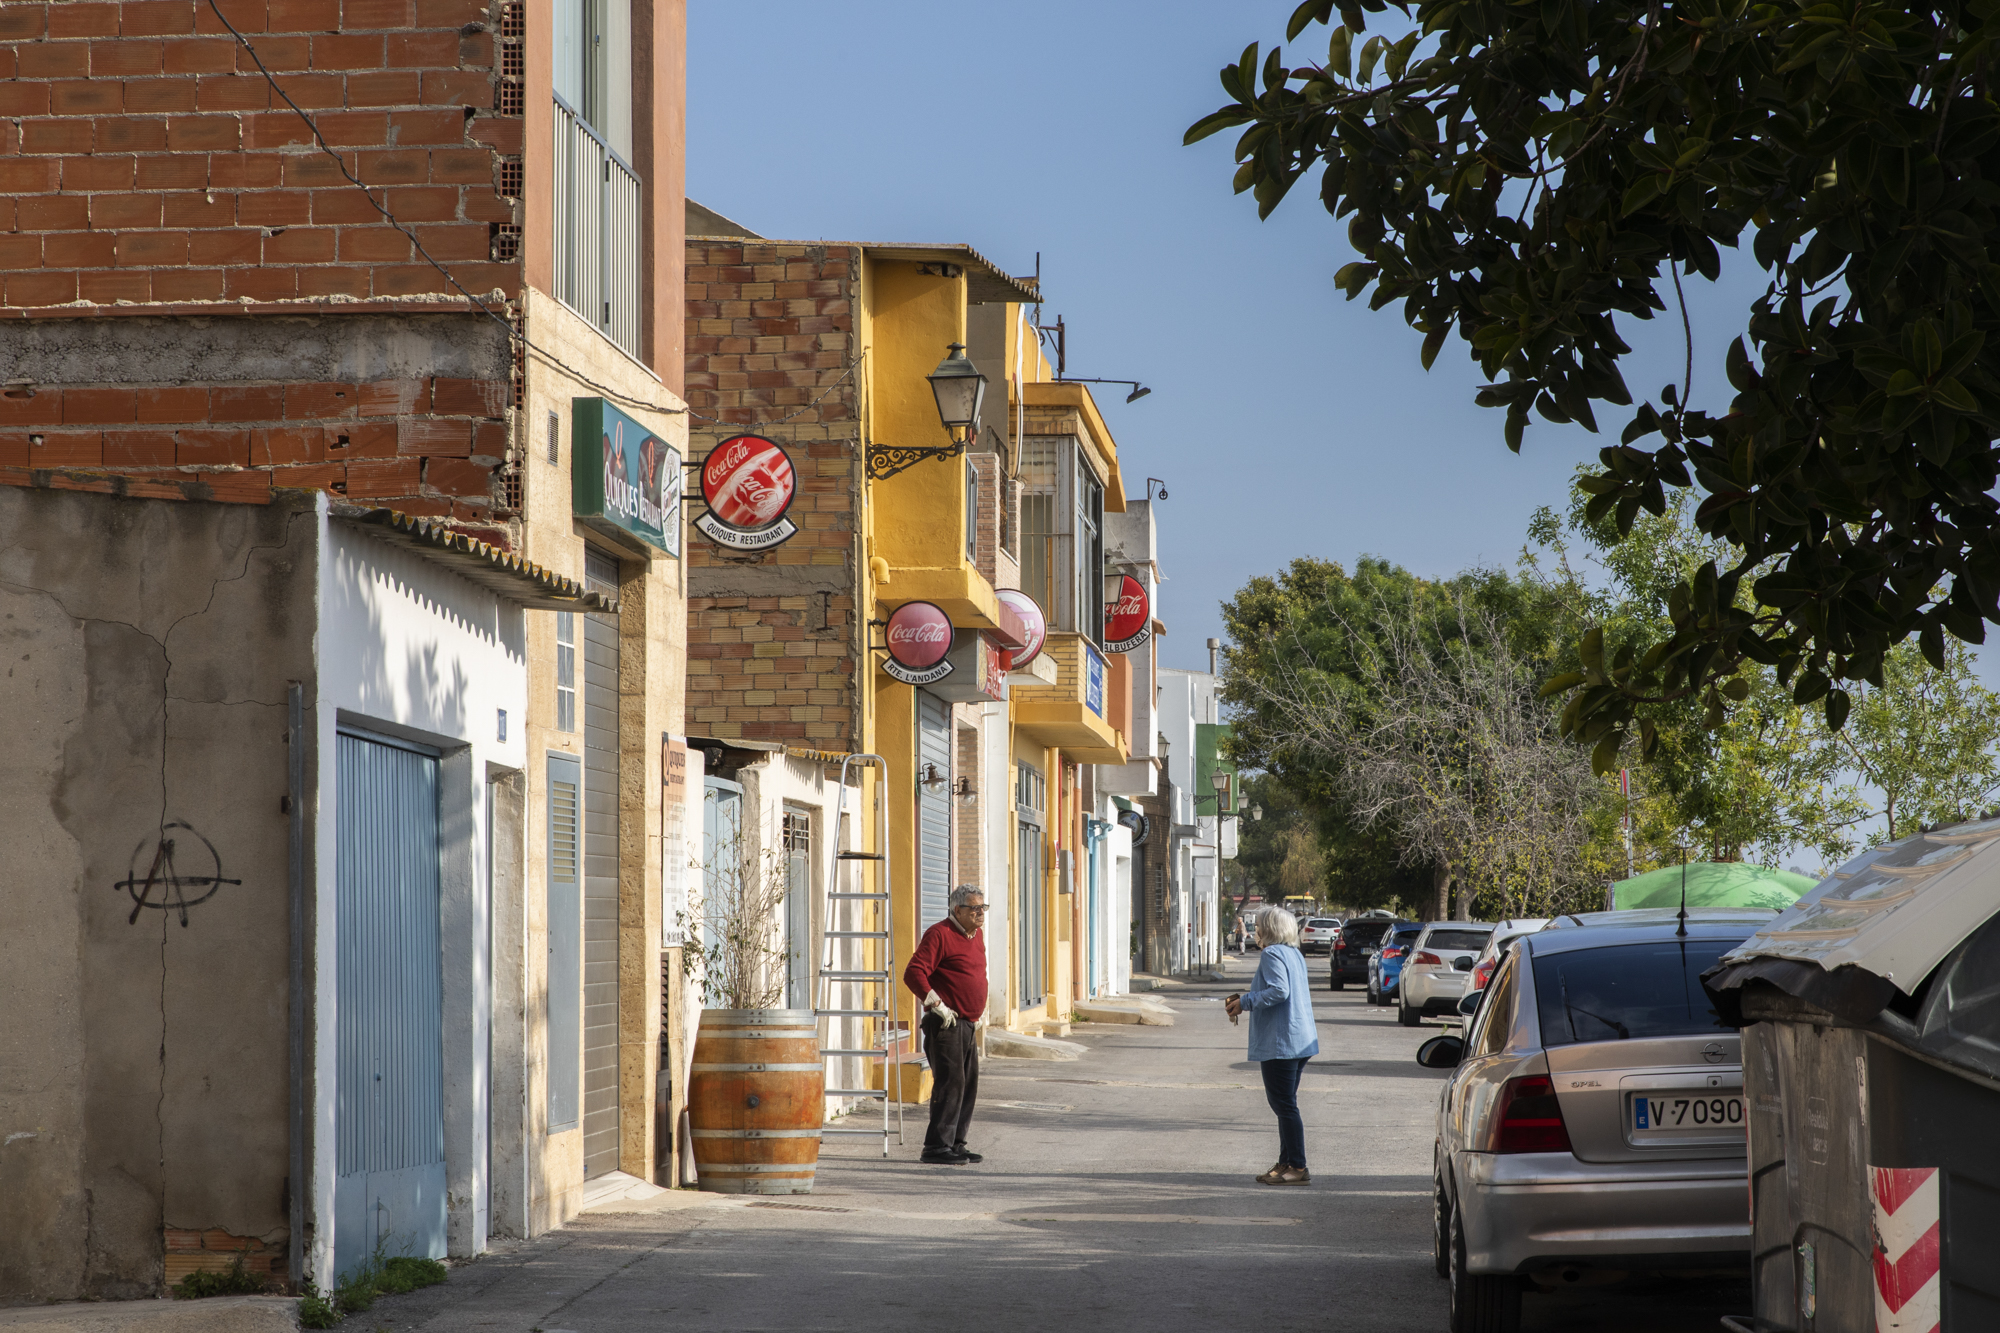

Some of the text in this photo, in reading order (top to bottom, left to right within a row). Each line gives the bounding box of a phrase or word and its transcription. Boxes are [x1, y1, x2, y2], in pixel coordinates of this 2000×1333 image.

[708, 438, 750, 486] Coca-Cola
[604, 460, 638, 519] QUIQUES
[706, 522, 784, 545] QUIQUES RESTAURANT
[889, 622, 948, 644] Coca-Cola
[1105, 632, 1147, 652] ALBUFERA
[887, 663, 947, 683] RTE. L'ANDANA
[1570, 1080, 1602, 1089] OPEL
